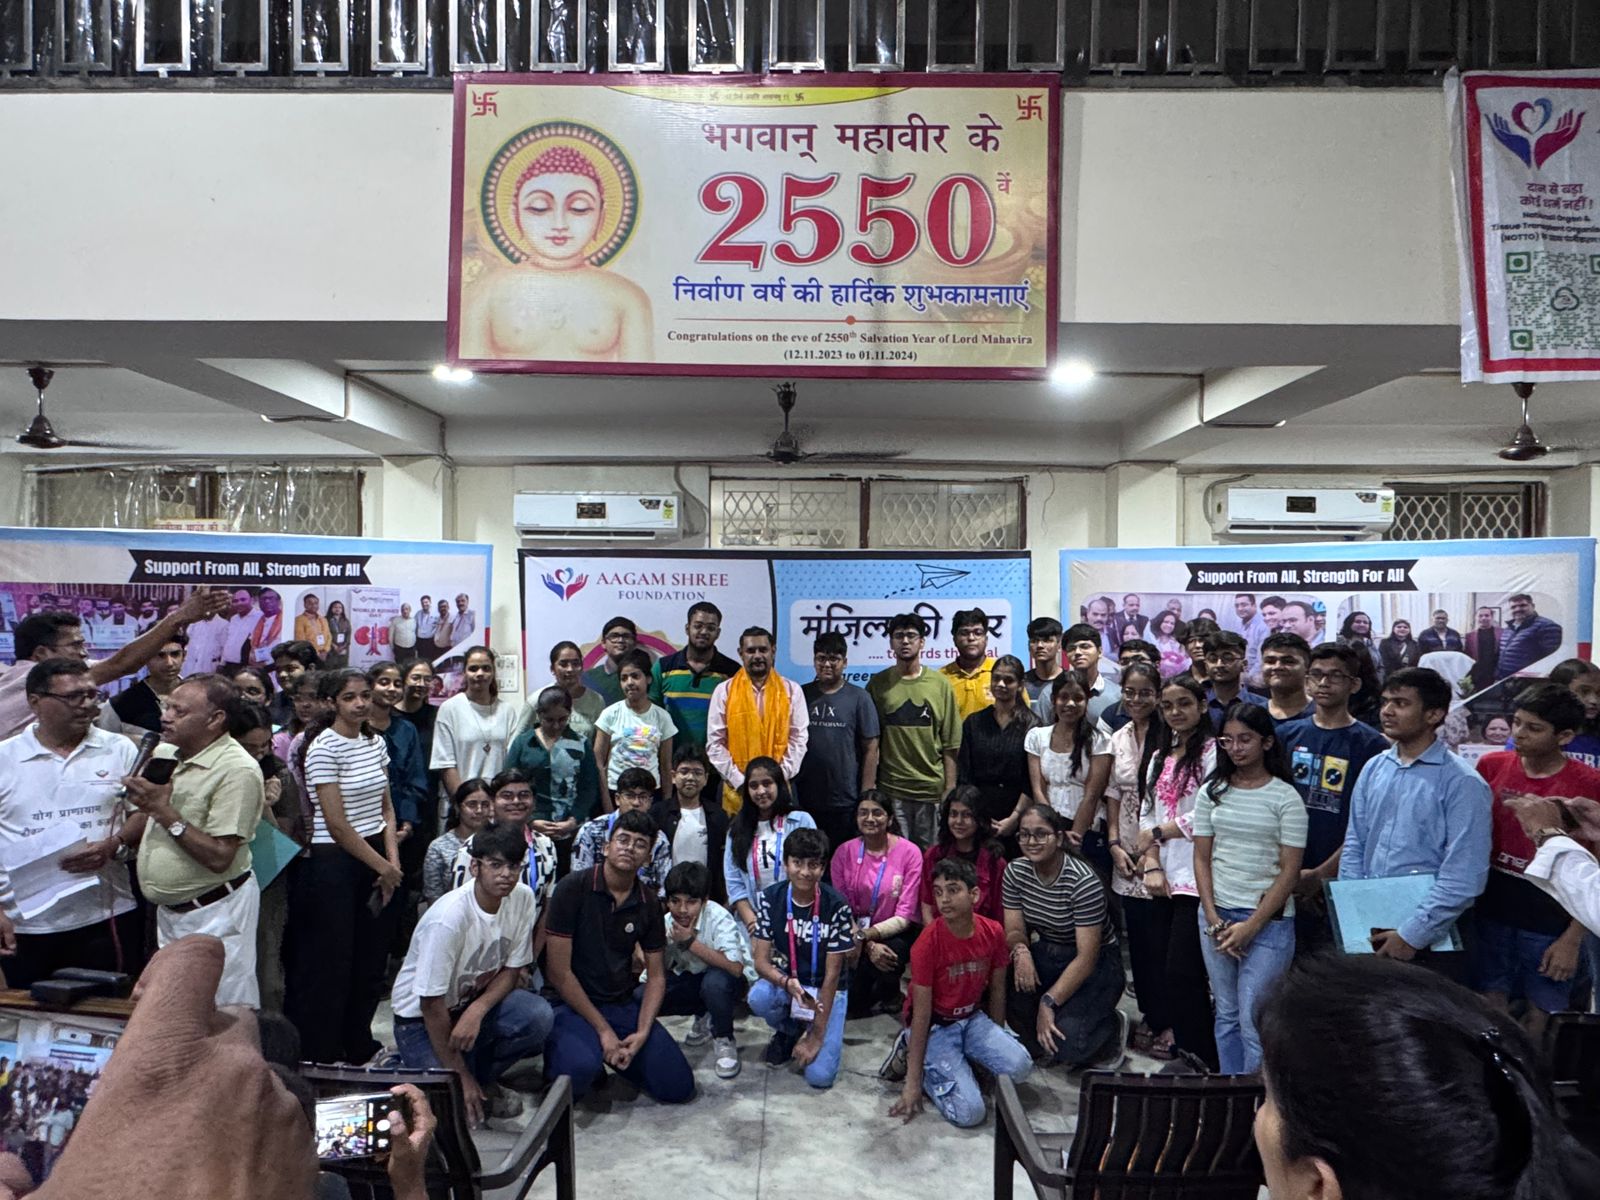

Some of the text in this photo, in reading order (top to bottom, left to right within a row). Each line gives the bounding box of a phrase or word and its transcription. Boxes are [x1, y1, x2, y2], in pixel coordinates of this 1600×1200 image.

[702, 113, 1003, 163] भगवान् महावीर के
[695, 172, 996, 271] 2550
[672, 275, 1030, 312] निर्वाण वर्ष की हार्दिक शुभकामनाएं
[667, 331, 753, 344] Congratulations
[755, 335, 770, 343] on
[772, 332, 788, 343] the
[791, 335, 810, 343] eve
[812, 332, 823, 343] of
[860, 332, 908, 344] Salvation
[911, 333, 936, 345] Year
[939, 334, 950, 345] of
[952, 334, 977, 345] Lord
[981, 335, 1033, 345] Mahavira
[784, 350, 918, 361] (12.11.2023 to 01.11.2024)
[144, 559, 360, 578] Support From All, Strength For All
[1197, 568, 1405, 585] Support From All, Strength For All
[596, 572, 729, 587] AAGAM SHREE
[618, 590, 706, 600] FOUNDATION
[32, 810, 52, 821] योग
